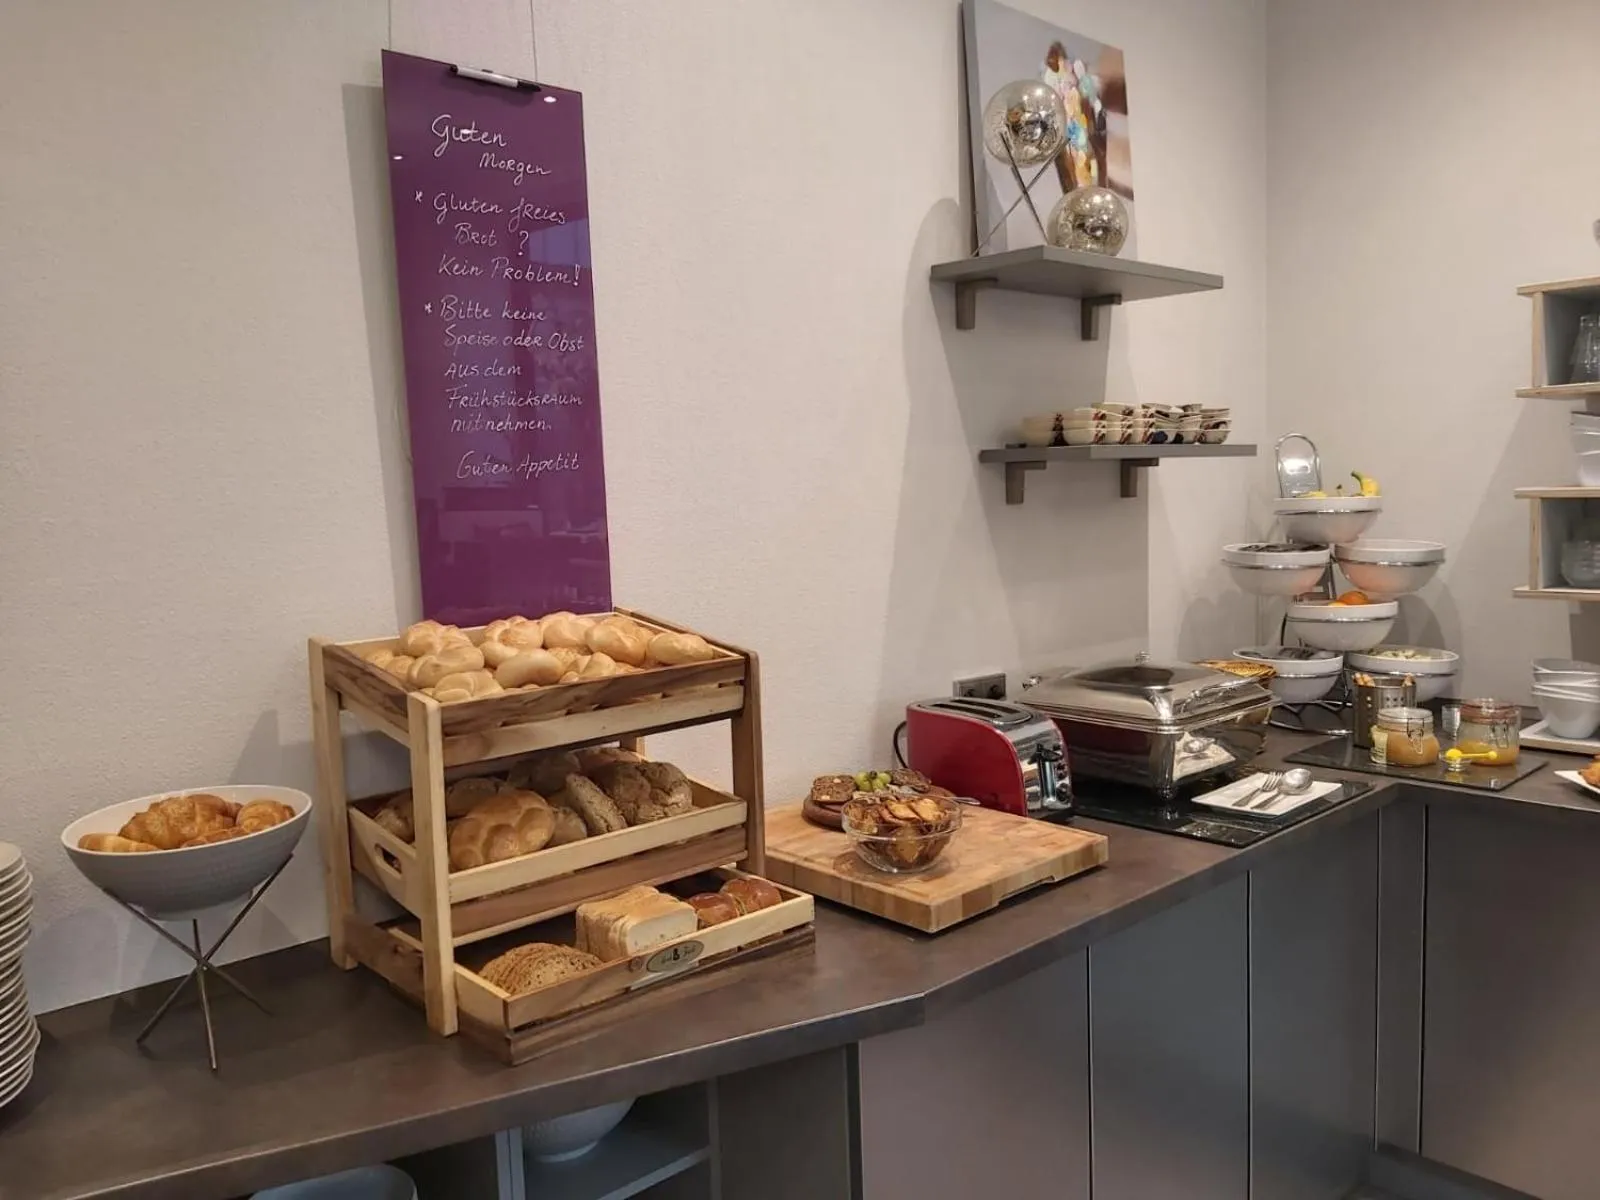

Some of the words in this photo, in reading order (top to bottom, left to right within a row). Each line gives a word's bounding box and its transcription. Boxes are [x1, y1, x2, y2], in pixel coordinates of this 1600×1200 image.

[431, 113, 507, 157] Guten
[433, 192, 503, 224] Gluten
[438, 253, 483, 276] Kein
[440, 294, 492, 322] Bitte
[502, 300, 547, 321] keine
[444, 323, 497, 357] Speise
[548, 332, 585, 352] Obst
[483, 358, 522, 377] dem
[456, 450, 512, 479] Guten
[516, 453, 580, 480] Appetit
